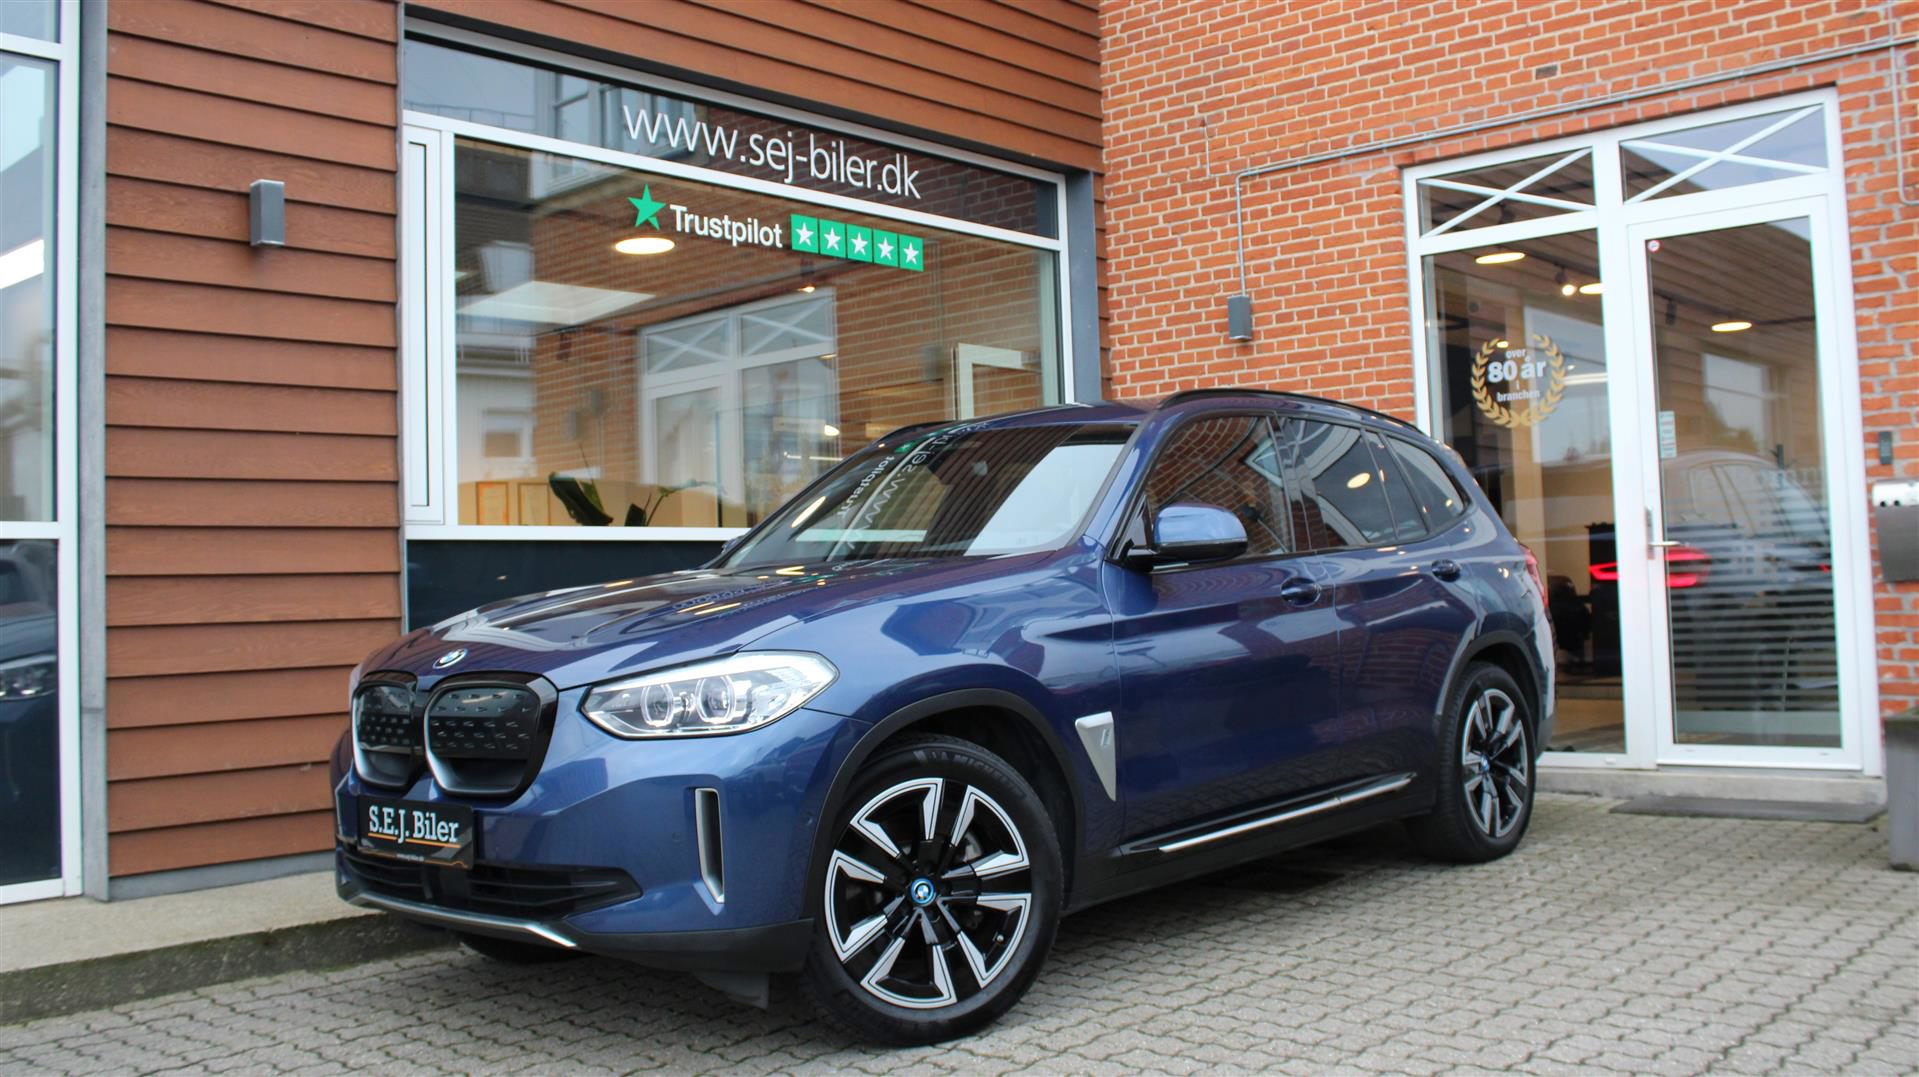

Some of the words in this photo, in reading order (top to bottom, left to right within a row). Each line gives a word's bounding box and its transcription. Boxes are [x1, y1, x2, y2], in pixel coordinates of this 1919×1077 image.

[623, 105, 921, 199] www.sej-biler.dk
[669, 204, 784, 249] Trustpilot
[1487, 360, 1518, 383] 80
[1520, 355, 1547, 379] år
[1505, 349, 1527, 360] over
[1496, 390, 1541, 402] branchen
[368, 805, 410, 844] S.E.J.
[412, 810, 459, 843] Biler
